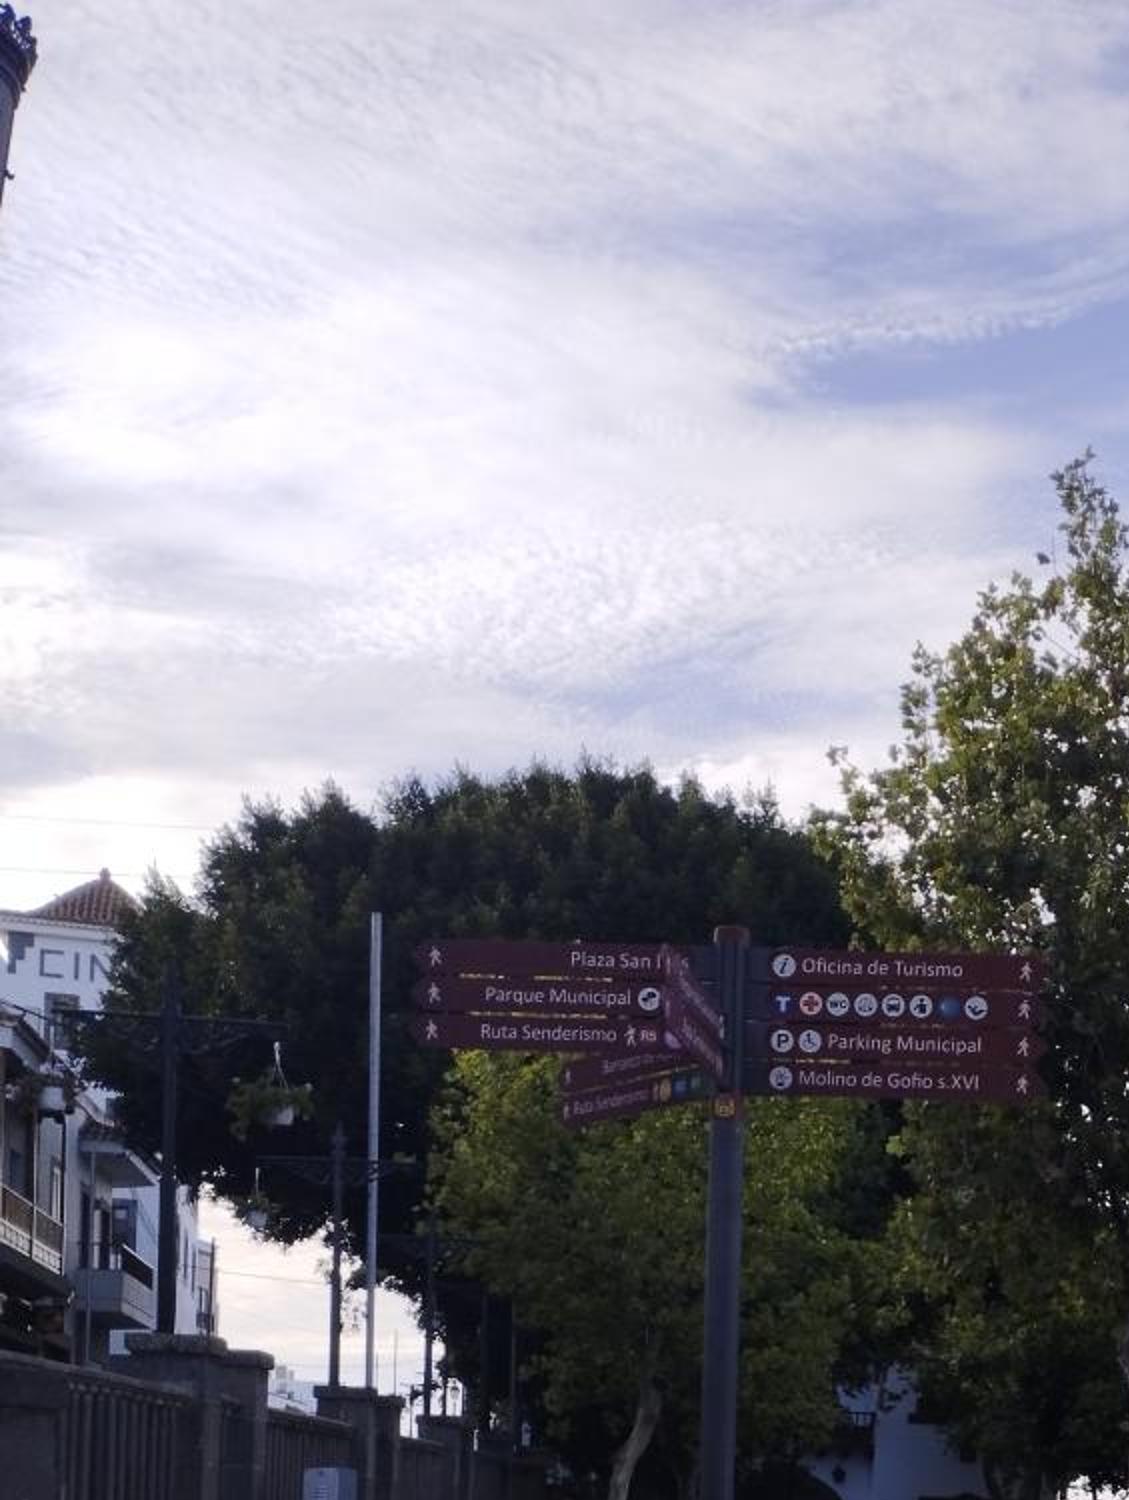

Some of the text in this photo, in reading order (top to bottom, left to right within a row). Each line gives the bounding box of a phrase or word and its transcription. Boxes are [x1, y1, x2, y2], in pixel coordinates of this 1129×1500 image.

[571, 950, 615, 967] Plaza
[619, 952, 651, 969] San
[802, 956, 963, 977] Oficina de Turismo
[485, 986, 631, 1007] Parque Municipal
[480, 1023, 517, 1040] Ruta
[521, 1025, 617, 1042] Senderismo
[828, 1033, 982, 1055] Parking Municipal
[800, 1070, 980, 1091] Molino de Gofio s.XVI
